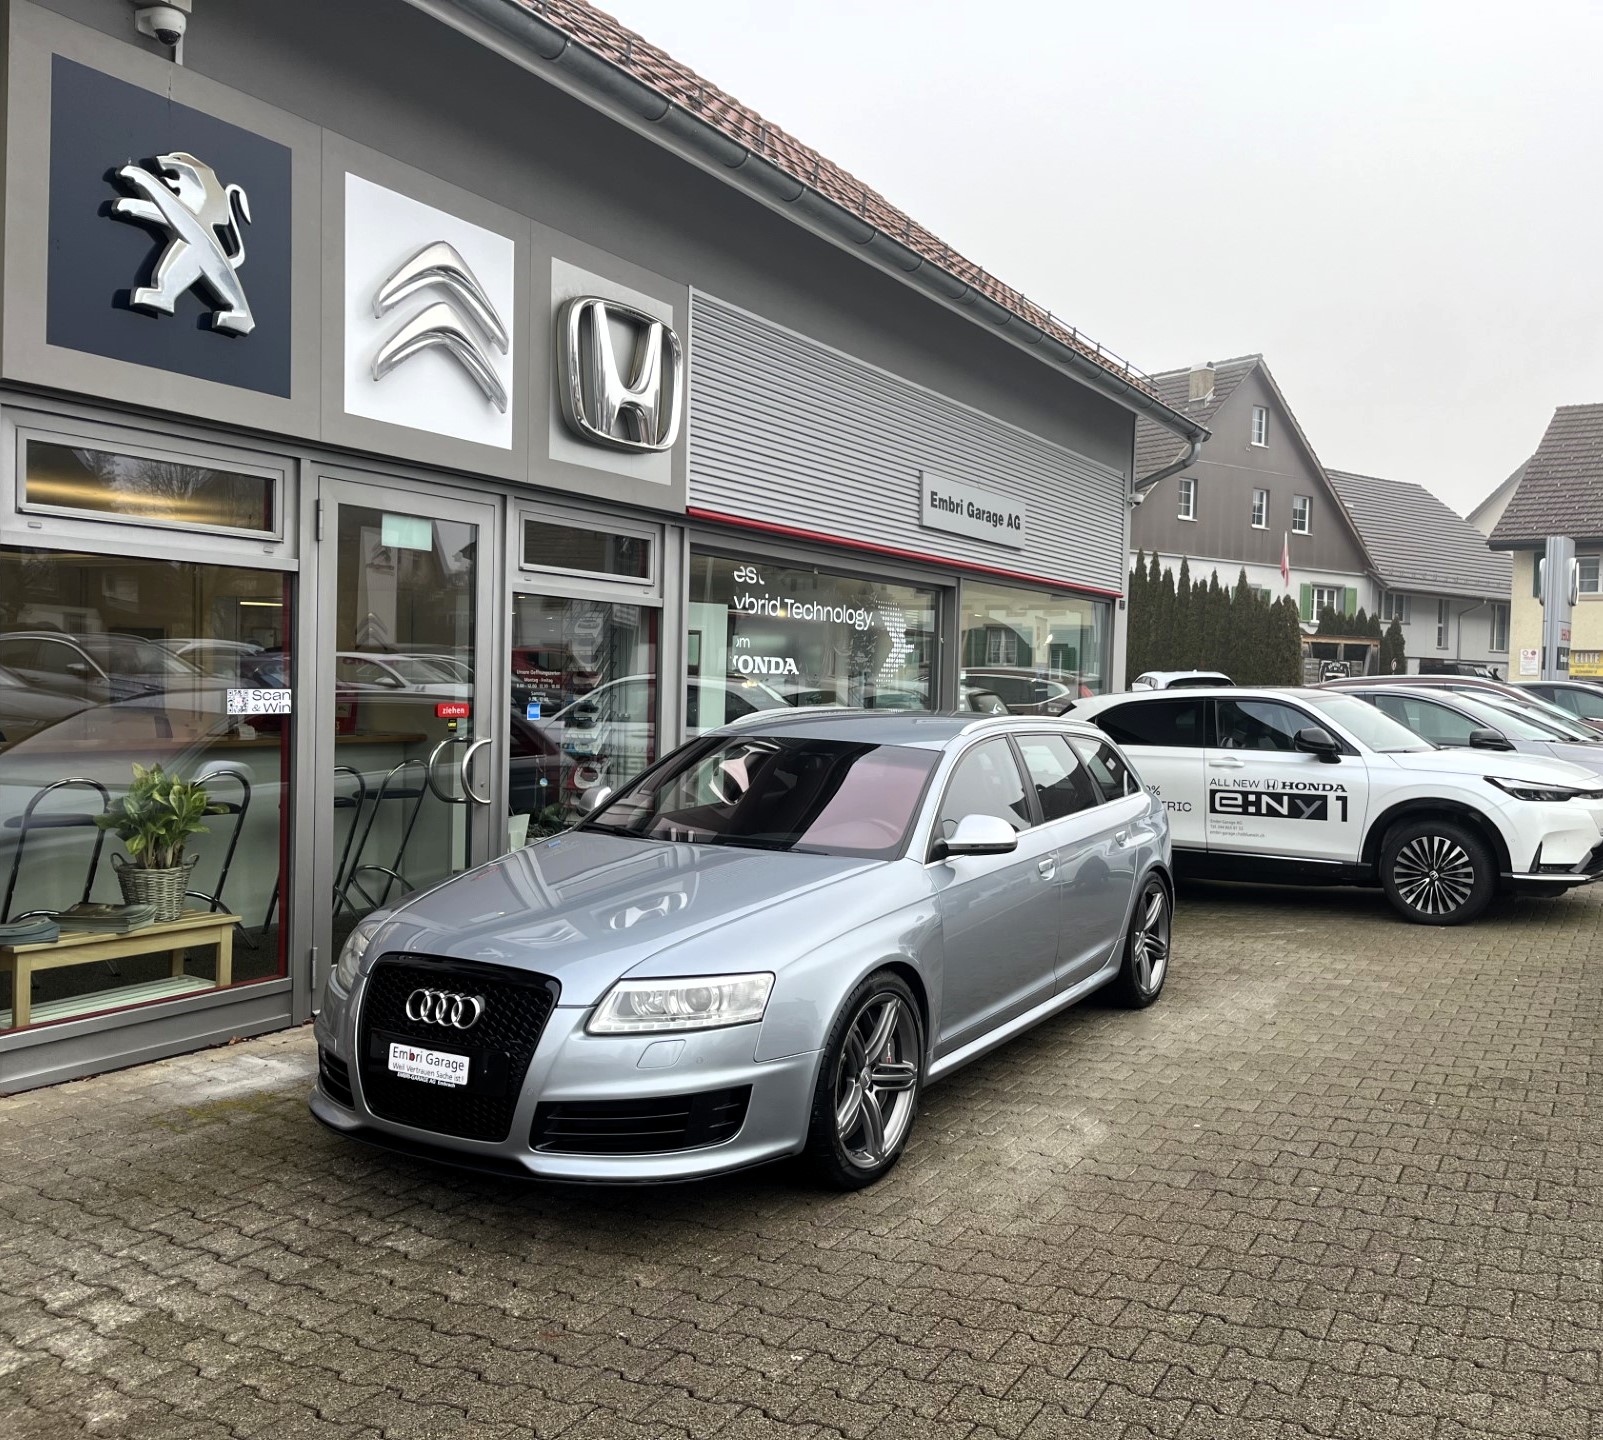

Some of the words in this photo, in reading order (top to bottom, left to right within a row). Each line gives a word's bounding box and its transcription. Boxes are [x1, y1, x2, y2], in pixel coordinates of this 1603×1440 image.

[930, 490, 964, 516] Embri
[966, 501, 1005, 528] Garage
[1006, 513, 1021, 531] AG
[784, 598, 876, 631] Technology.
[252, 689, 291, 701] Scan
[251, 703, 261, 712] &
[263, 701, 291, 713] Win
[442, 705, 466, 715] ziehen
[1209, 778, 1230, 787] ALL
[1232, 779, 1260, 788] NEW
[1281, 781, 1348, 793] HONDA
[1161, 800, 1192, 812] RIC
[392, 1046, 423, 1063] Embri
[425, 1052, 465, 1073] Garage
